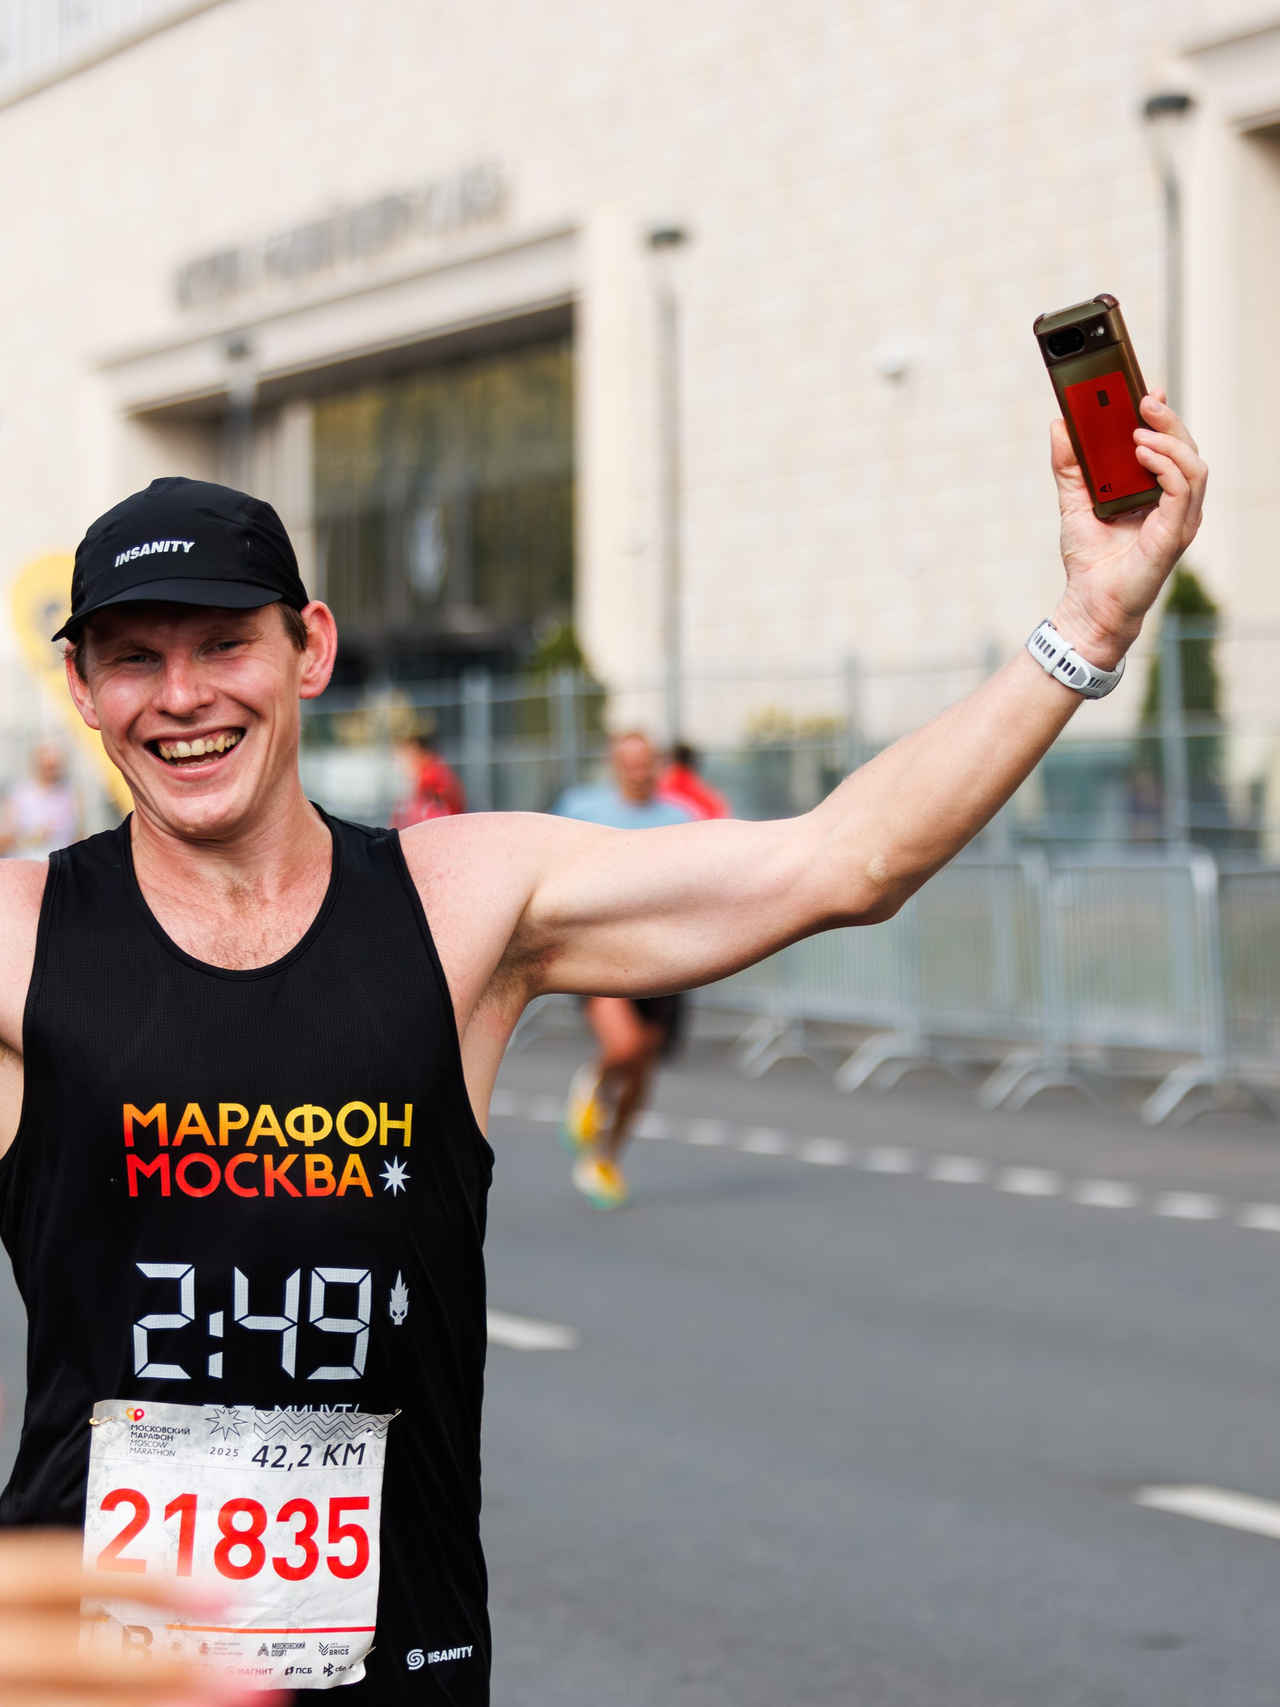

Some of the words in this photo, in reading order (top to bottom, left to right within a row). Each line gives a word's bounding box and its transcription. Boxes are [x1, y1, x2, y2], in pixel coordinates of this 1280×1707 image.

[115, 541, 195, 568] INSANITY
[122, 1100, 413, 1147] МАРАФОН
[126, 1152, 374, 1198] МОСКВА
[133, 1262, 372, 1380] 2:49
[130, 1424, 191, 1435] МОСКОВСКИЙ
[130, 1431, 174, 1441] МАРАФОН
[129, 1439, 168, 1449] MOSCOW
[129, 1447, 176, 1457] MARATHON
[209, 1447, 239, 1457] 2025
[251, 1444, 312, 1471] 42,2
[96, 1487, 370, 1582] 21835
[271, 1641, 306, 1650] МОСКОВСКИЙ
[329, 1648, 350, 1656] BRICS
[237, 1667, 273, 1676] МАГНИТ
[295, 1667, 313, 1675] ПСБ
